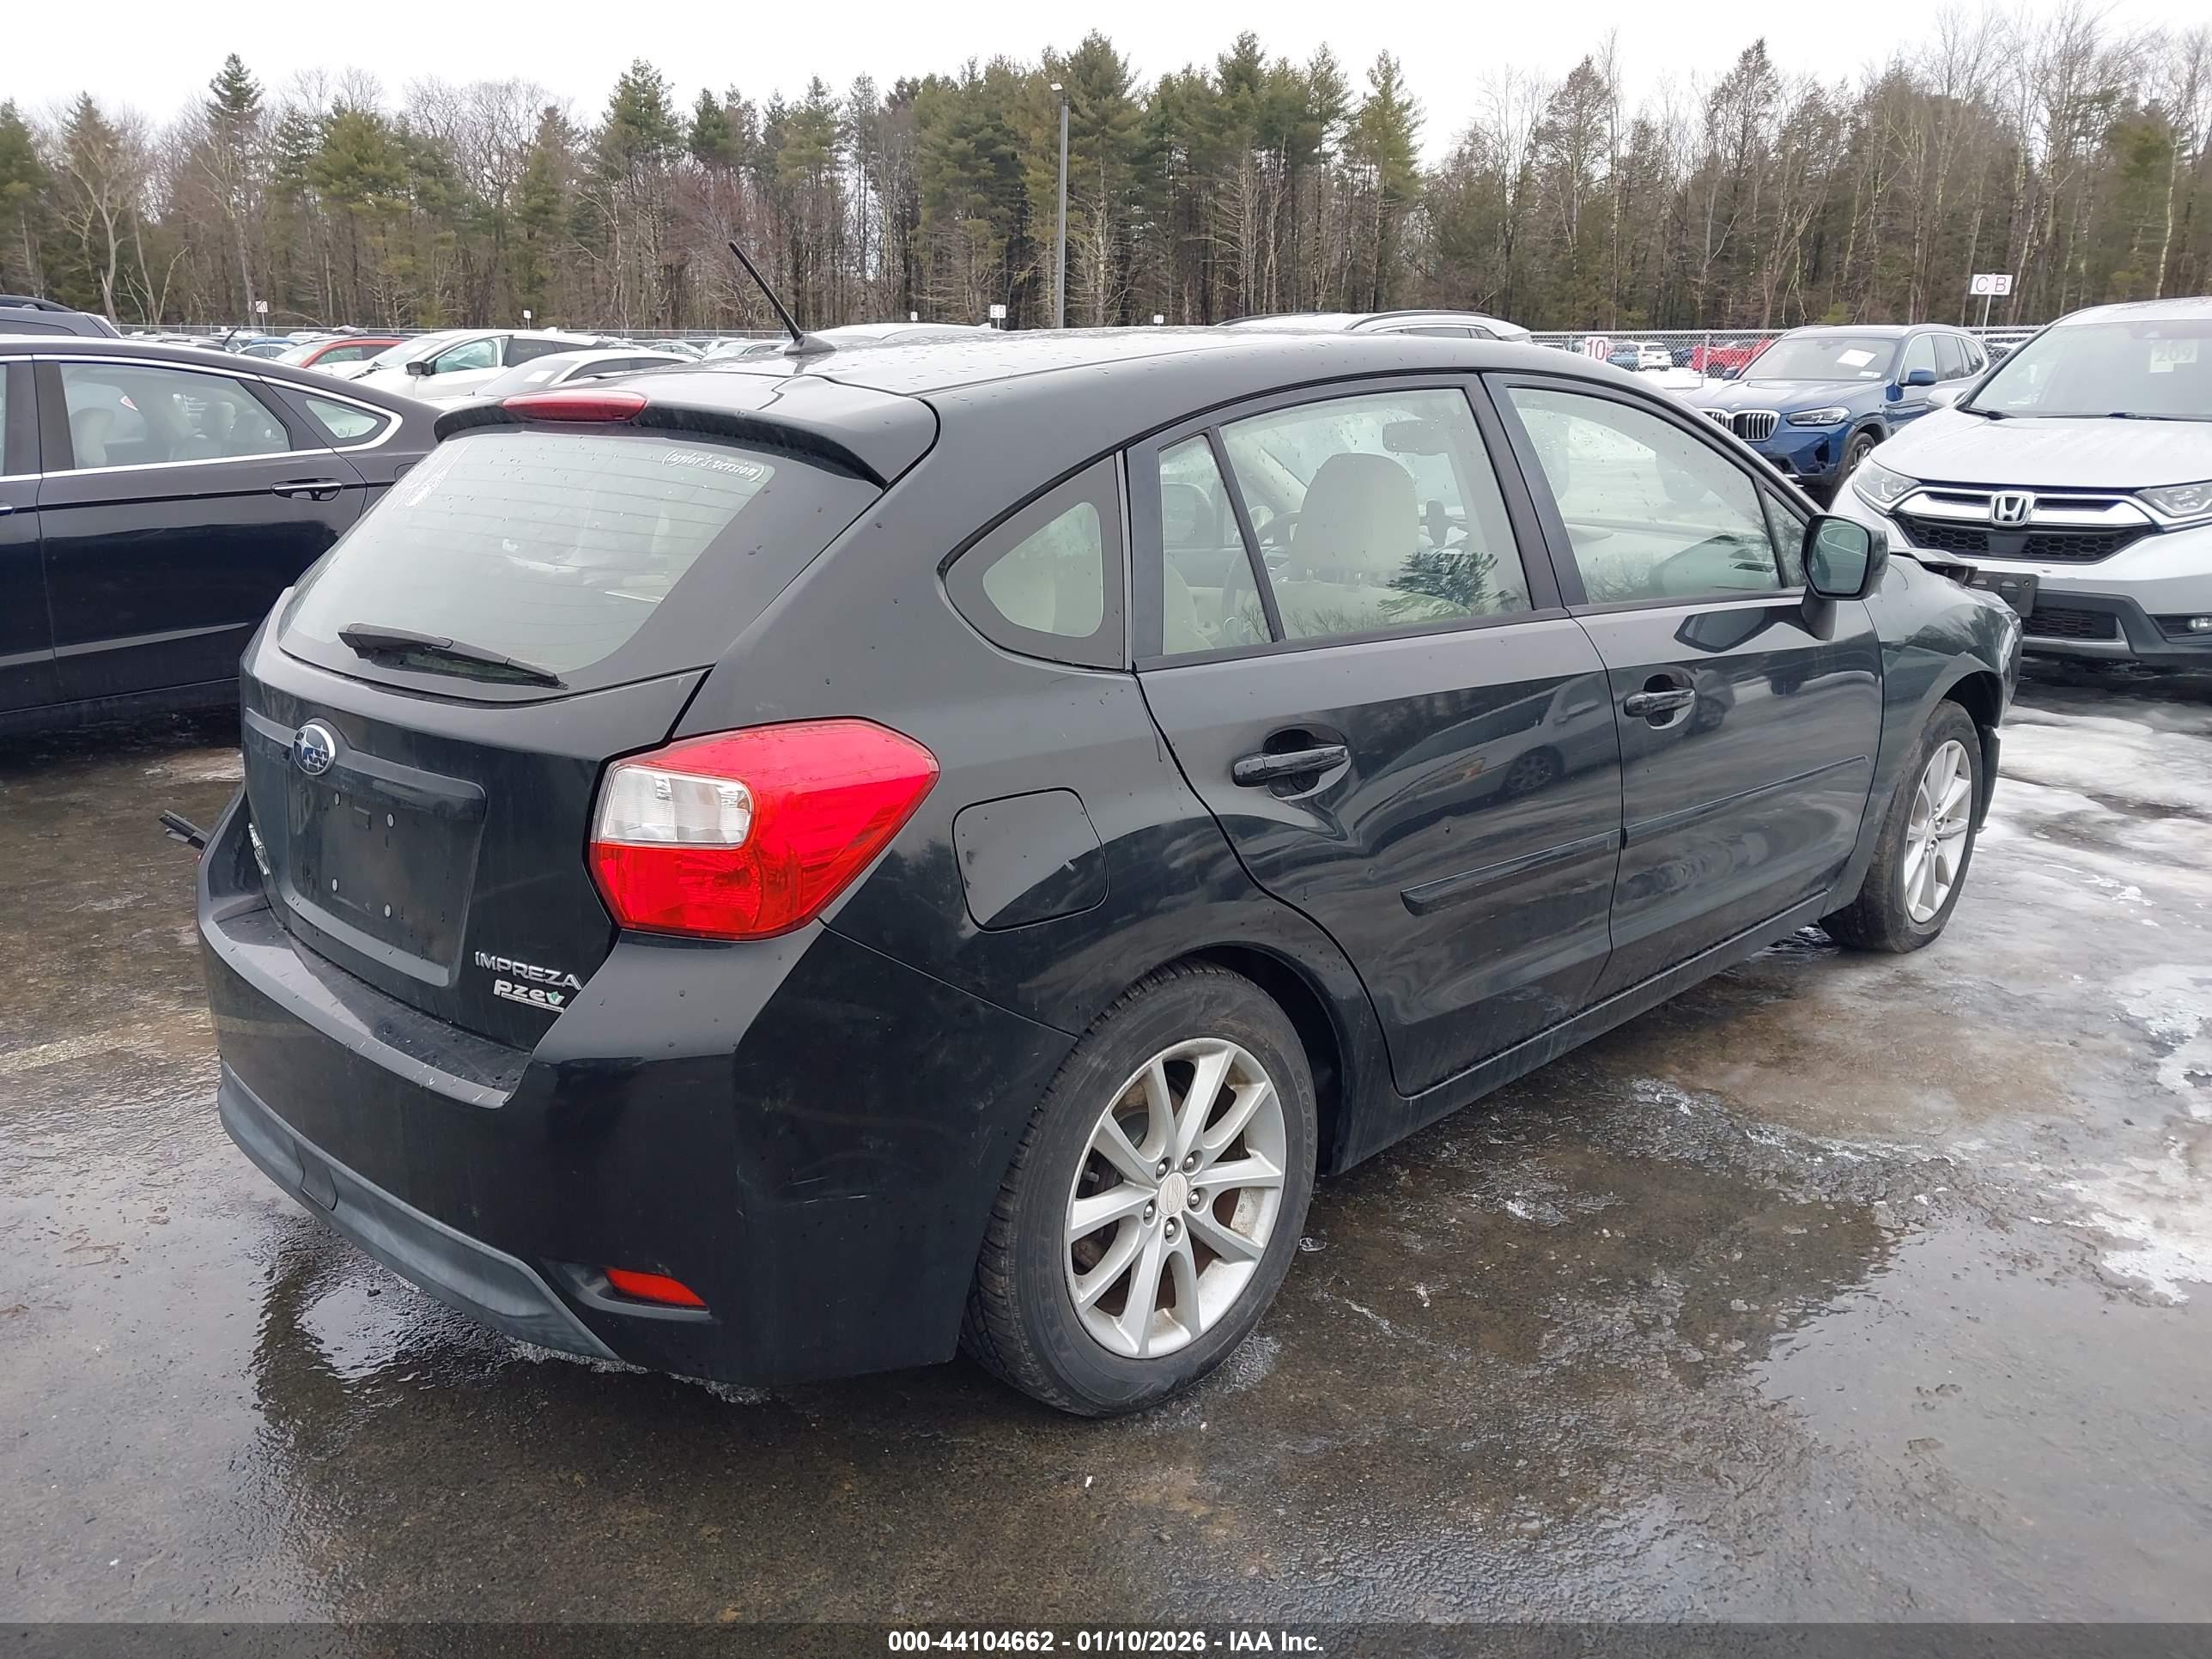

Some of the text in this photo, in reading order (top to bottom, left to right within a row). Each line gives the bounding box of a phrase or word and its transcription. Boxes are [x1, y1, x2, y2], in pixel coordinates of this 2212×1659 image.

[1586, 339, 1606, 361] 10
[661, 449, 764, 482] (taylor's version)
[475, 951, 583, 991] IMPREZA
